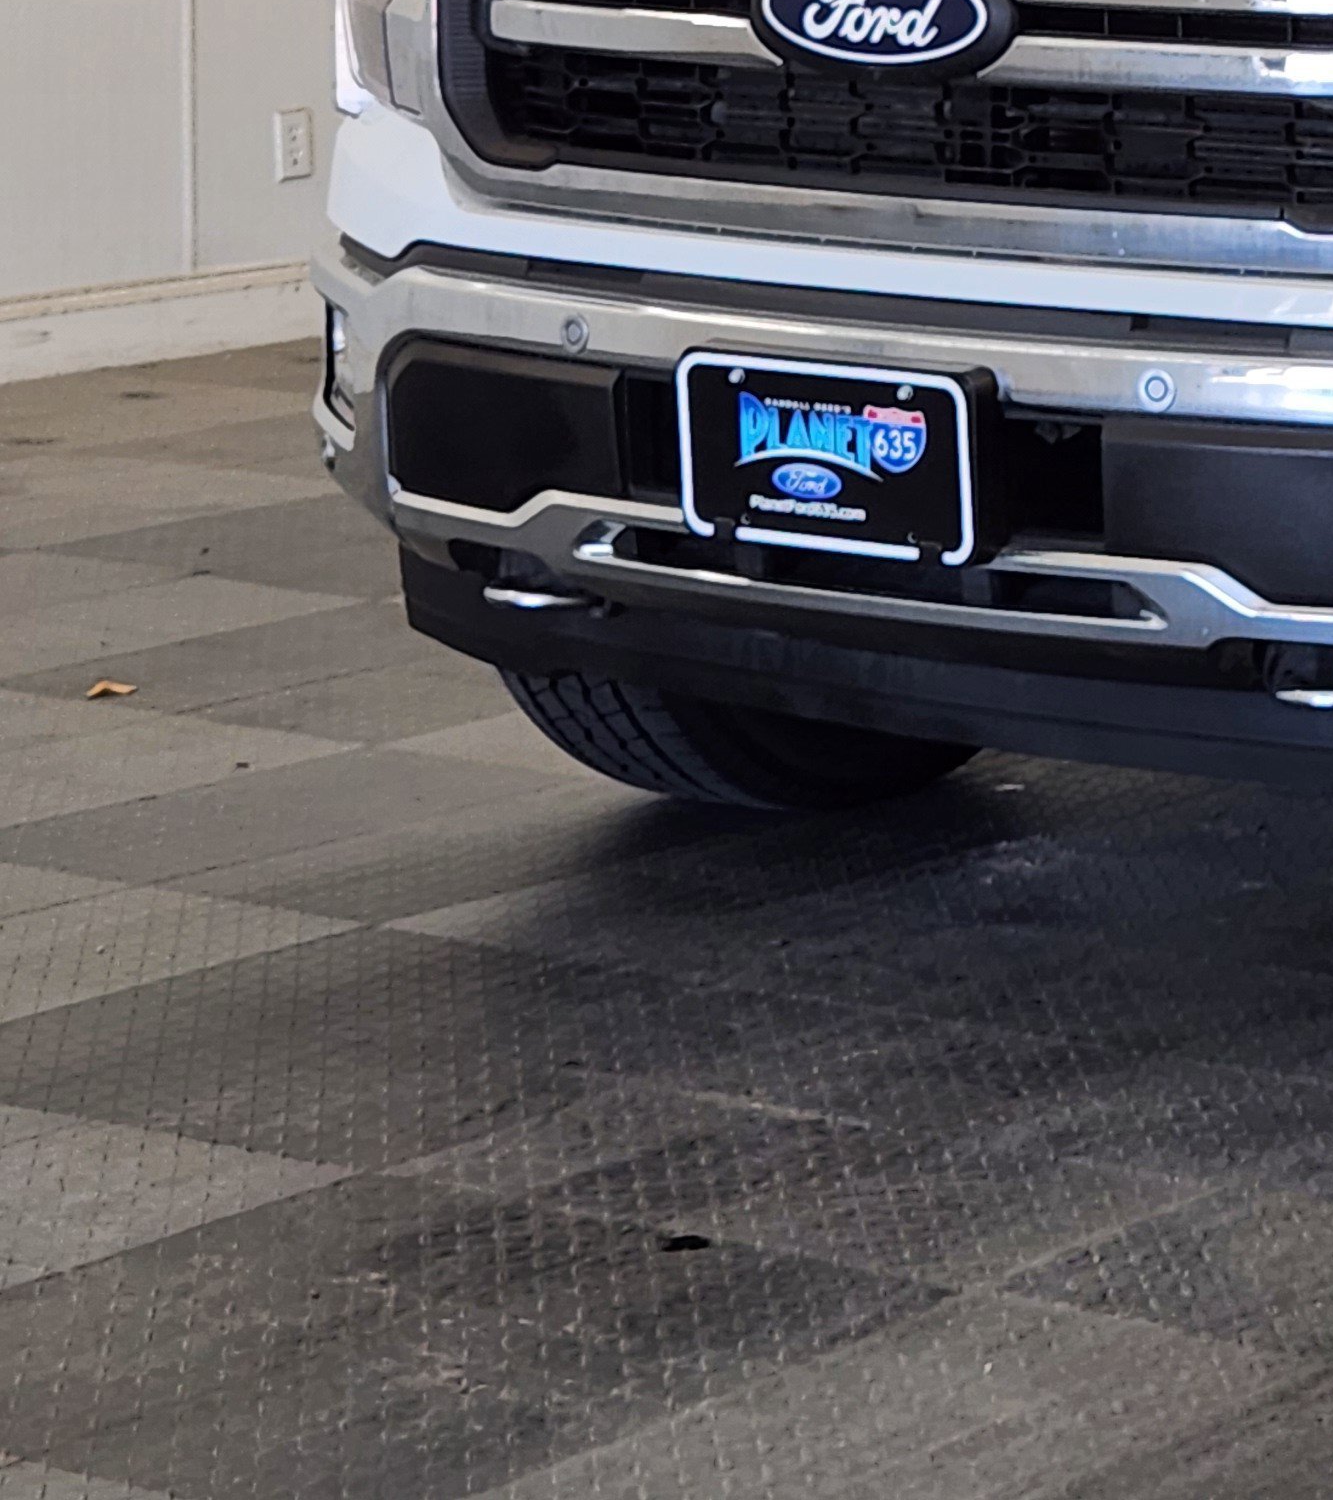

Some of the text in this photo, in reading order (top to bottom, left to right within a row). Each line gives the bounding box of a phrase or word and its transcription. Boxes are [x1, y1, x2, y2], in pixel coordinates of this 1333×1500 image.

[738, 390, 872, 472] PLANET
[874, 428, 917, 461] 635
[785, 469, 829, 495] Ford
